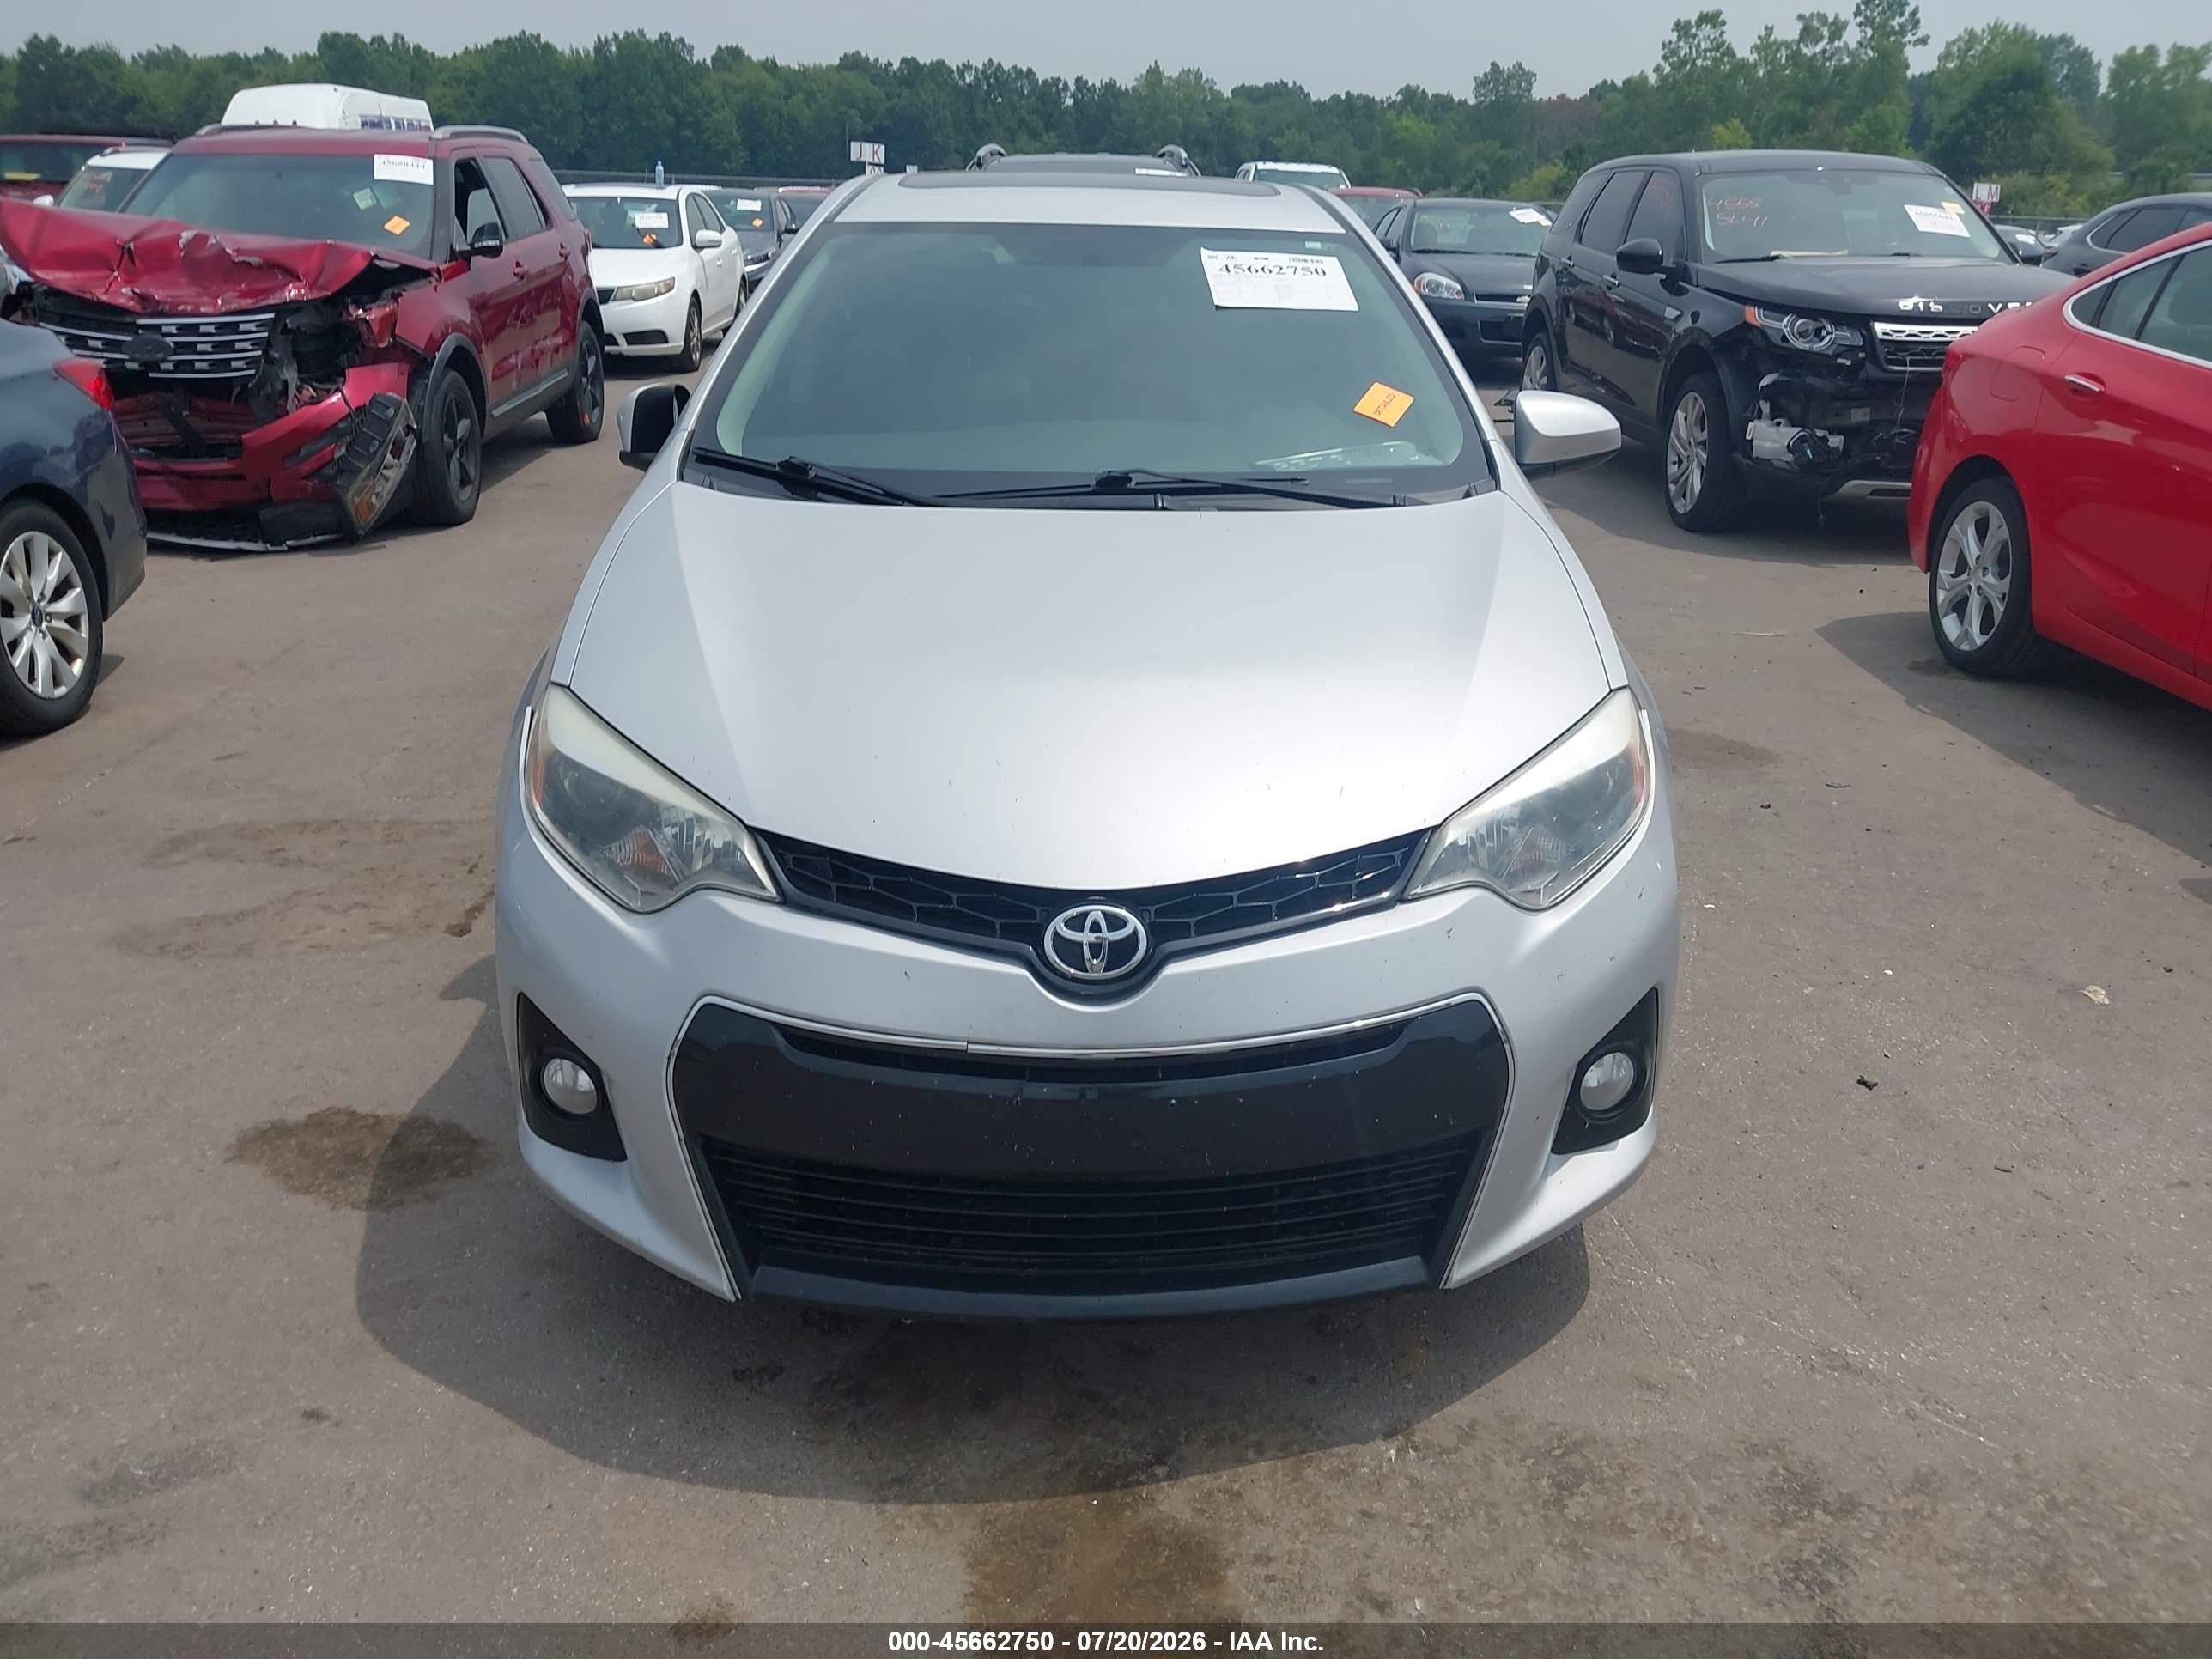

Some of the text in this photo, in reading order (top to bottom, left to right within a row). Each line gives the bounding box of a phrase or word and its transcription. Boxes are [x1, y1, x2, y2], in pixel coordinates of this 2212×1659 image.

[871, 143, 882, 164] K
[1986, 185, 1999, 200] M
[1218, 263, 1328, 277] 45662750
